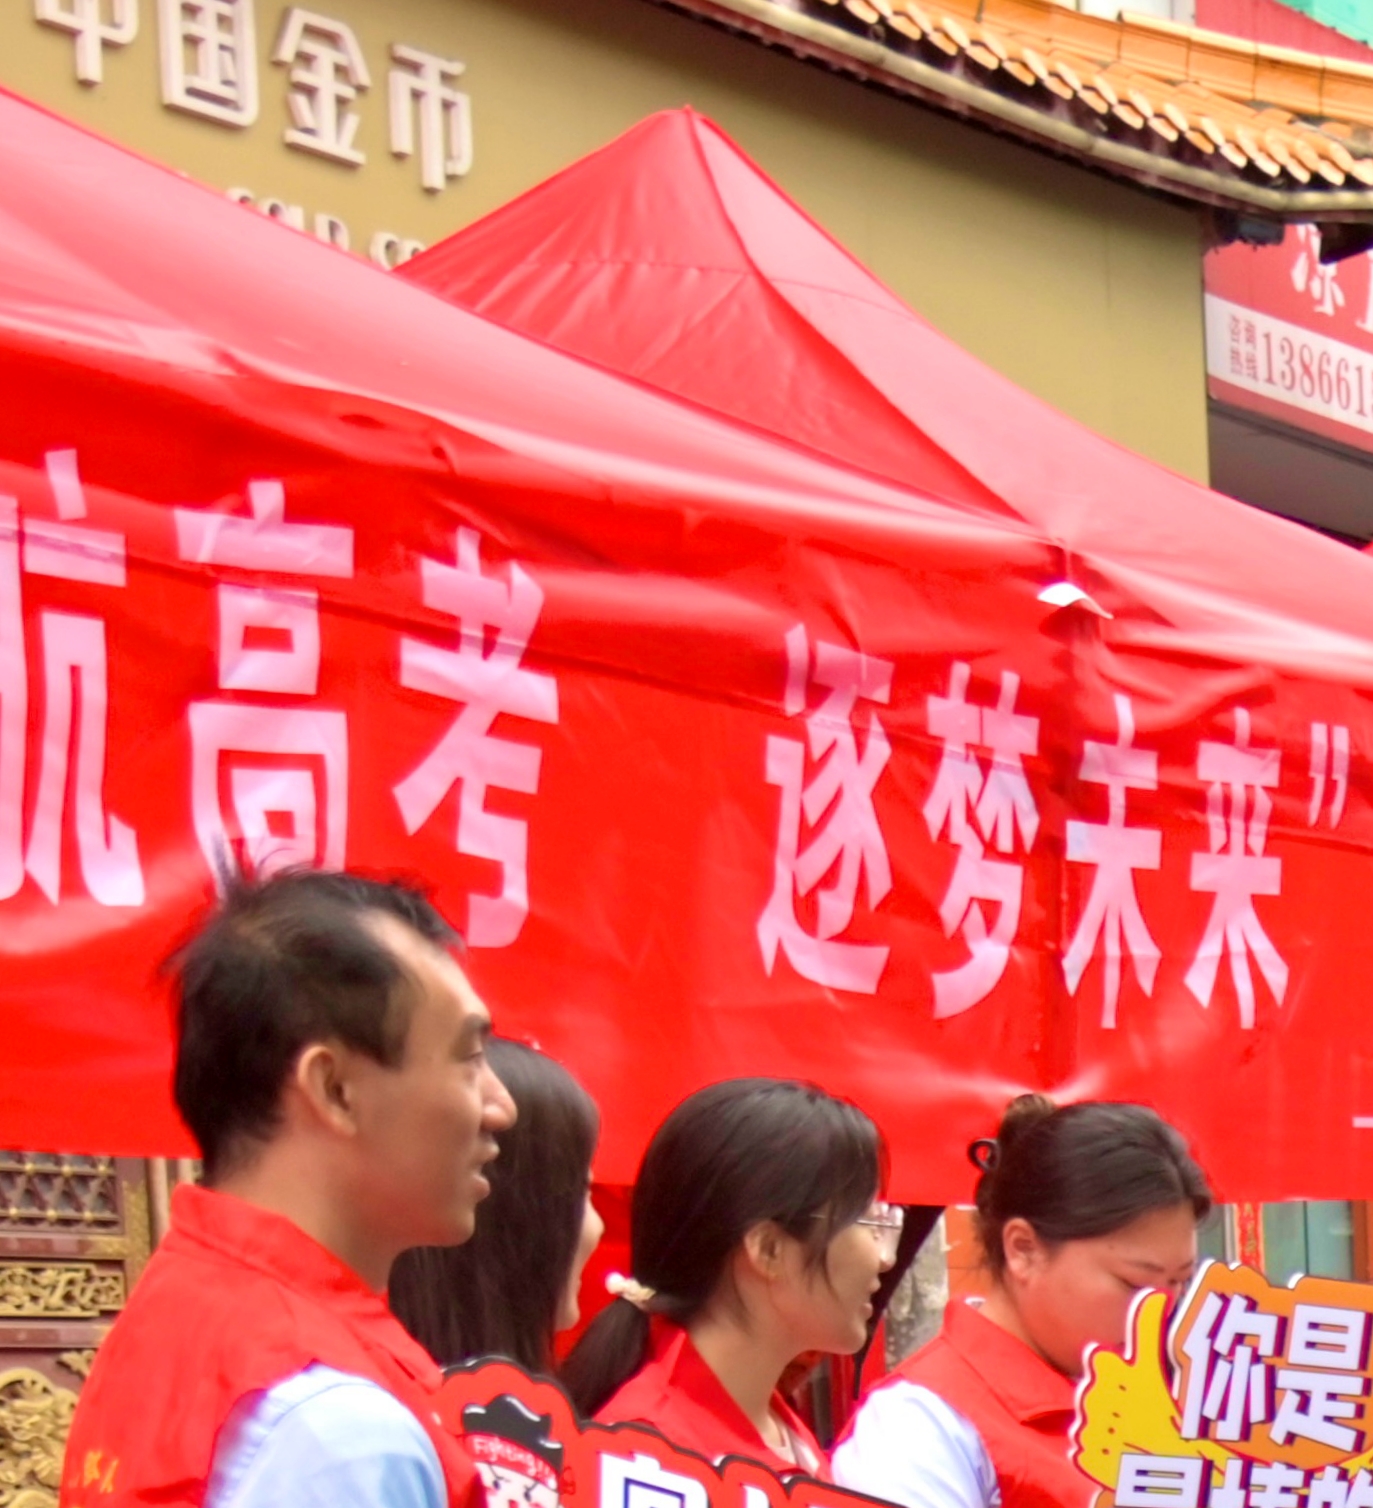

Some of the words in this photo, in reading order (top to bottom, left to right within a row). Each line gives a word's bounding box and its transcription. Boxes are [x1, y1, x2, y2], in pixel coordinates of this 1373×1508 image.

[34, 0, 474, 192] 中国金币
[1180, 1291, 1373, 1454] 你是
